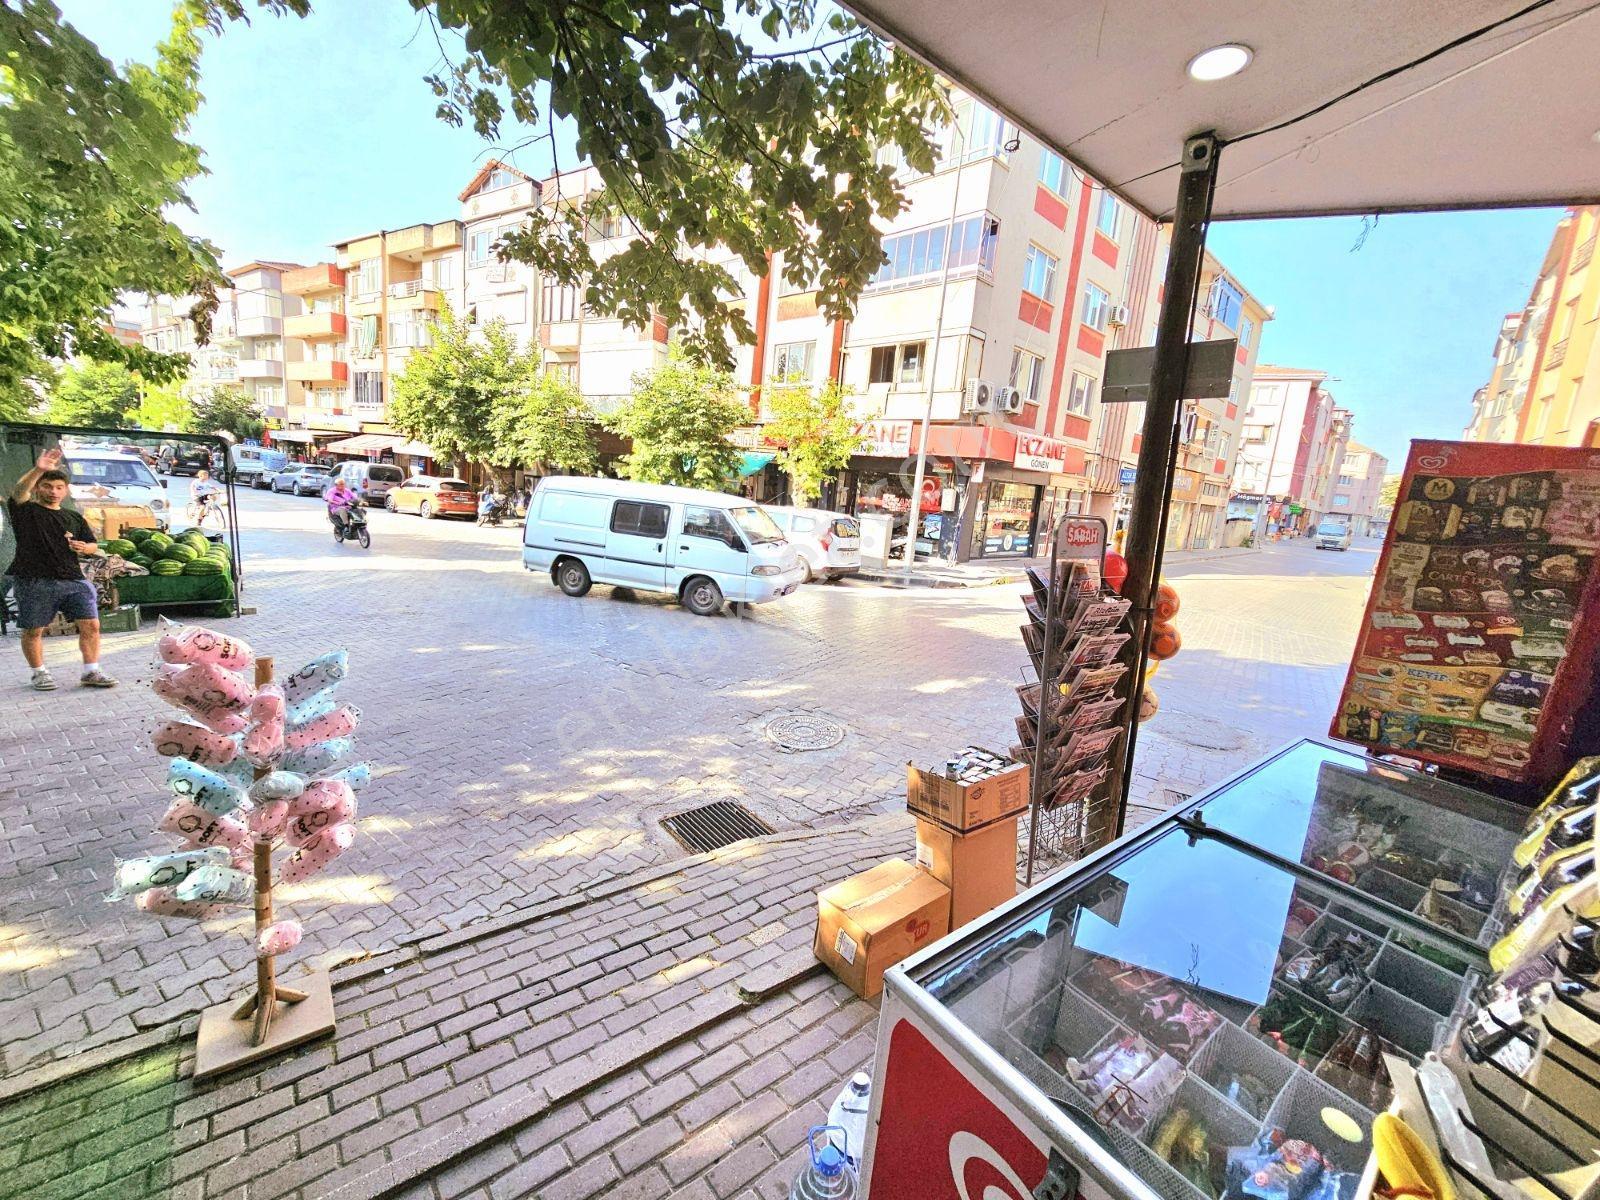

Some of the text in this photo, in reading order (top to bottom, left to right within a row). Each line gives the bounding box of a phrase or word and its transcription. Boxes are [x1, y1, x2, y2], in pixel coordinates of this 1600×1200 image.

[1020, 436, 1066, 460] ECZANE
[1030, 458, 1050, 469] GÖNEN
[1067, 527, 1098, 544] SABAH
[198, 819, 220, 844] SOFT
